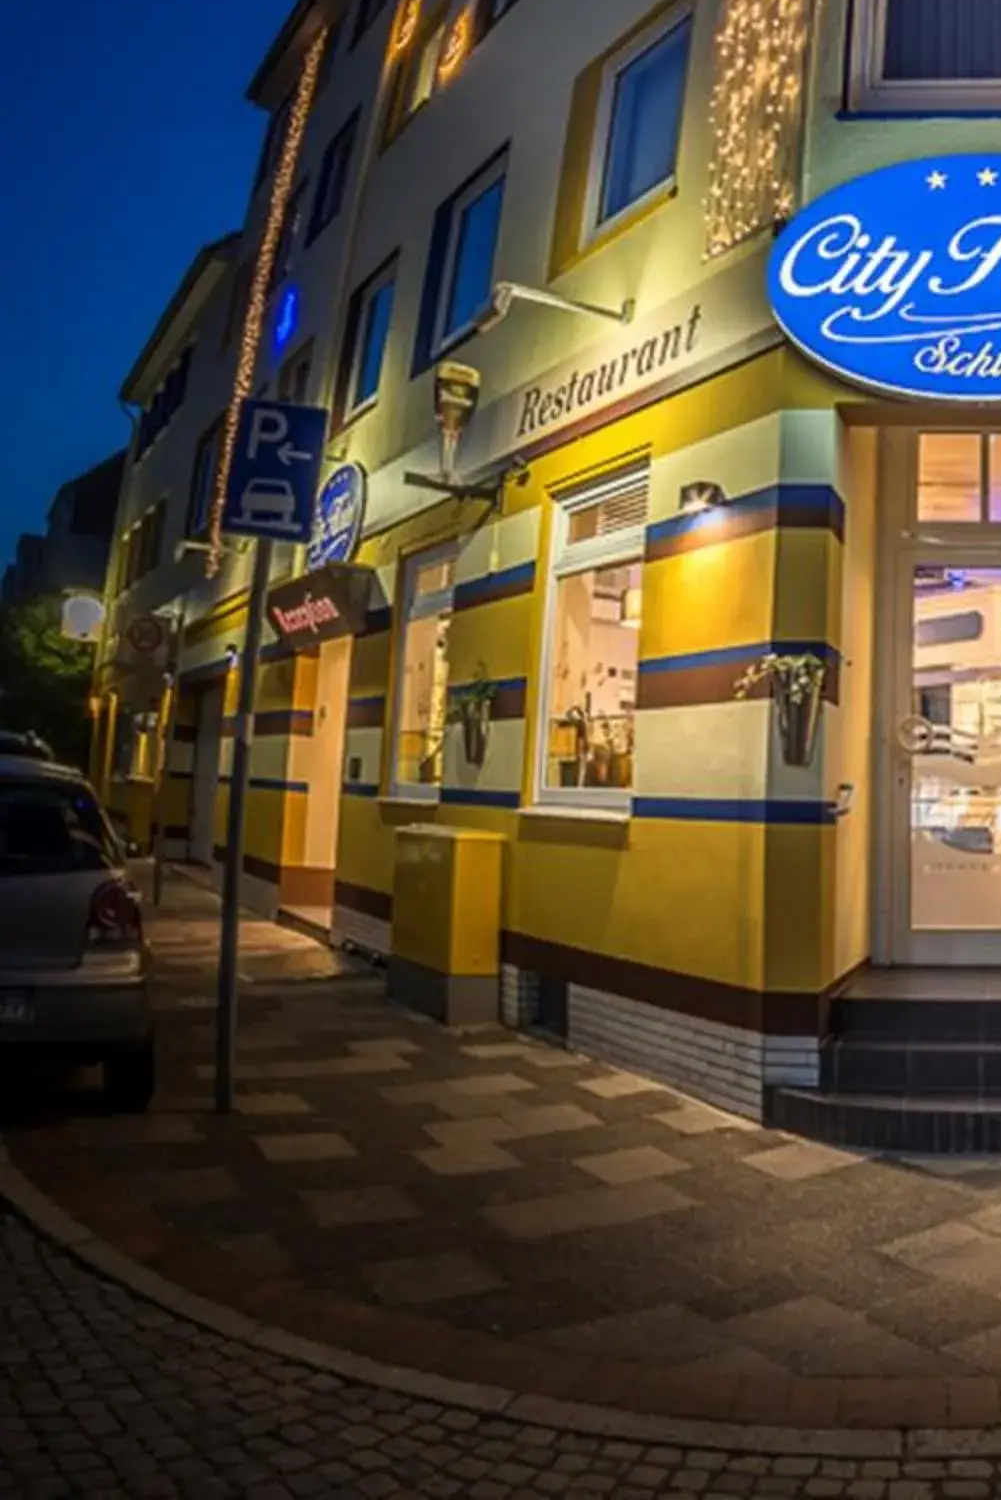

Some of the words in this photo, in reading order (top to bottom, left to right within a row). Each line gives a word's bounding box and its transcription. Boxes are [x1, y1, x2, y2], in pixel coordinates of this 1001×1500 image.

[778, 213, 934, 320] City
[516, 304, 702, 438] Restaurant
[247, 409, 289, 459] P
